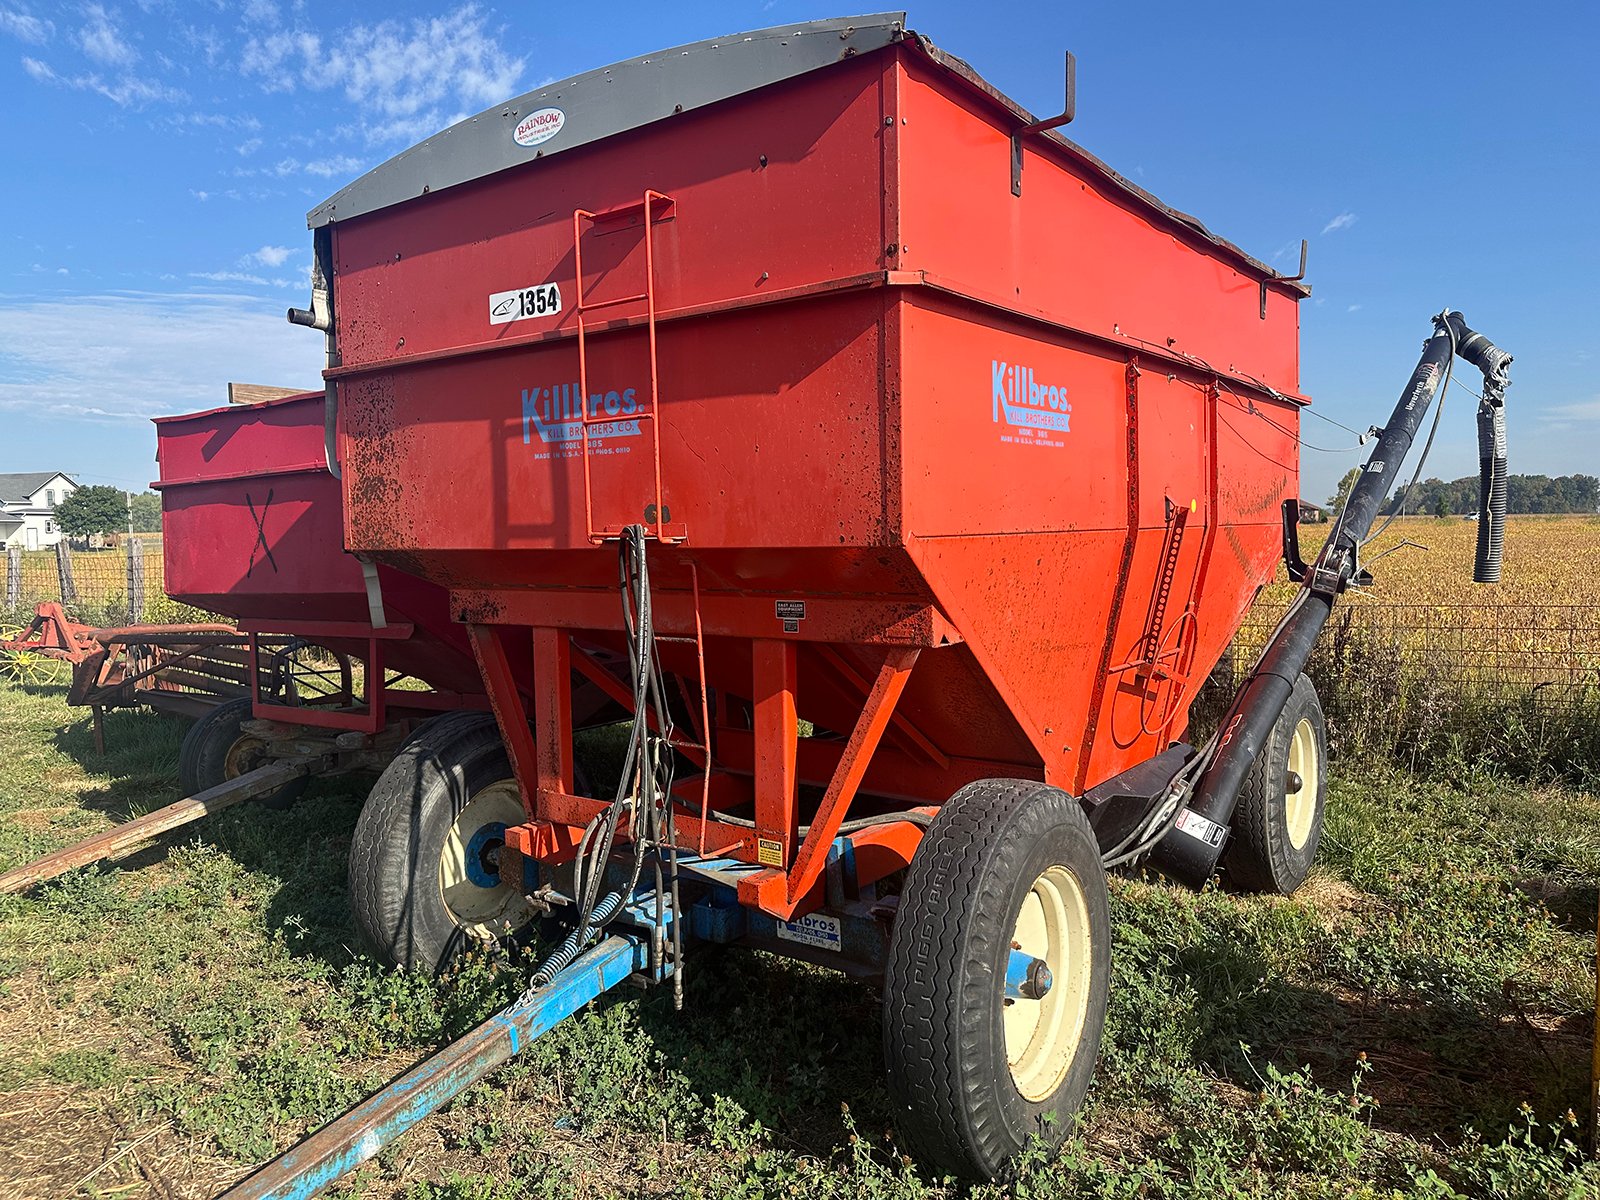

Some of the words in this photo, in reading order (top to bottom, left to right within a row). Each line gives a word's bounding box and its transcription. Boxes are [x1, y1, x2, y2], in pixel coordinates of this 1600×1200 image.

[518, 113, 560, 135] RAINBOW
[519, 286, 557, 317] 1354
[992, 360, 1072, 422] Killbros.
[1010, 411, 1023, 422] KILL
[1026, 412, 1054, 426] BROTHERS
[547, 428, 564, 439] KILL
[617, 421, 634, 433] CO.
[560, 441, 581, 450] MODEL
[761, 841, 780, 850] CAUTION
